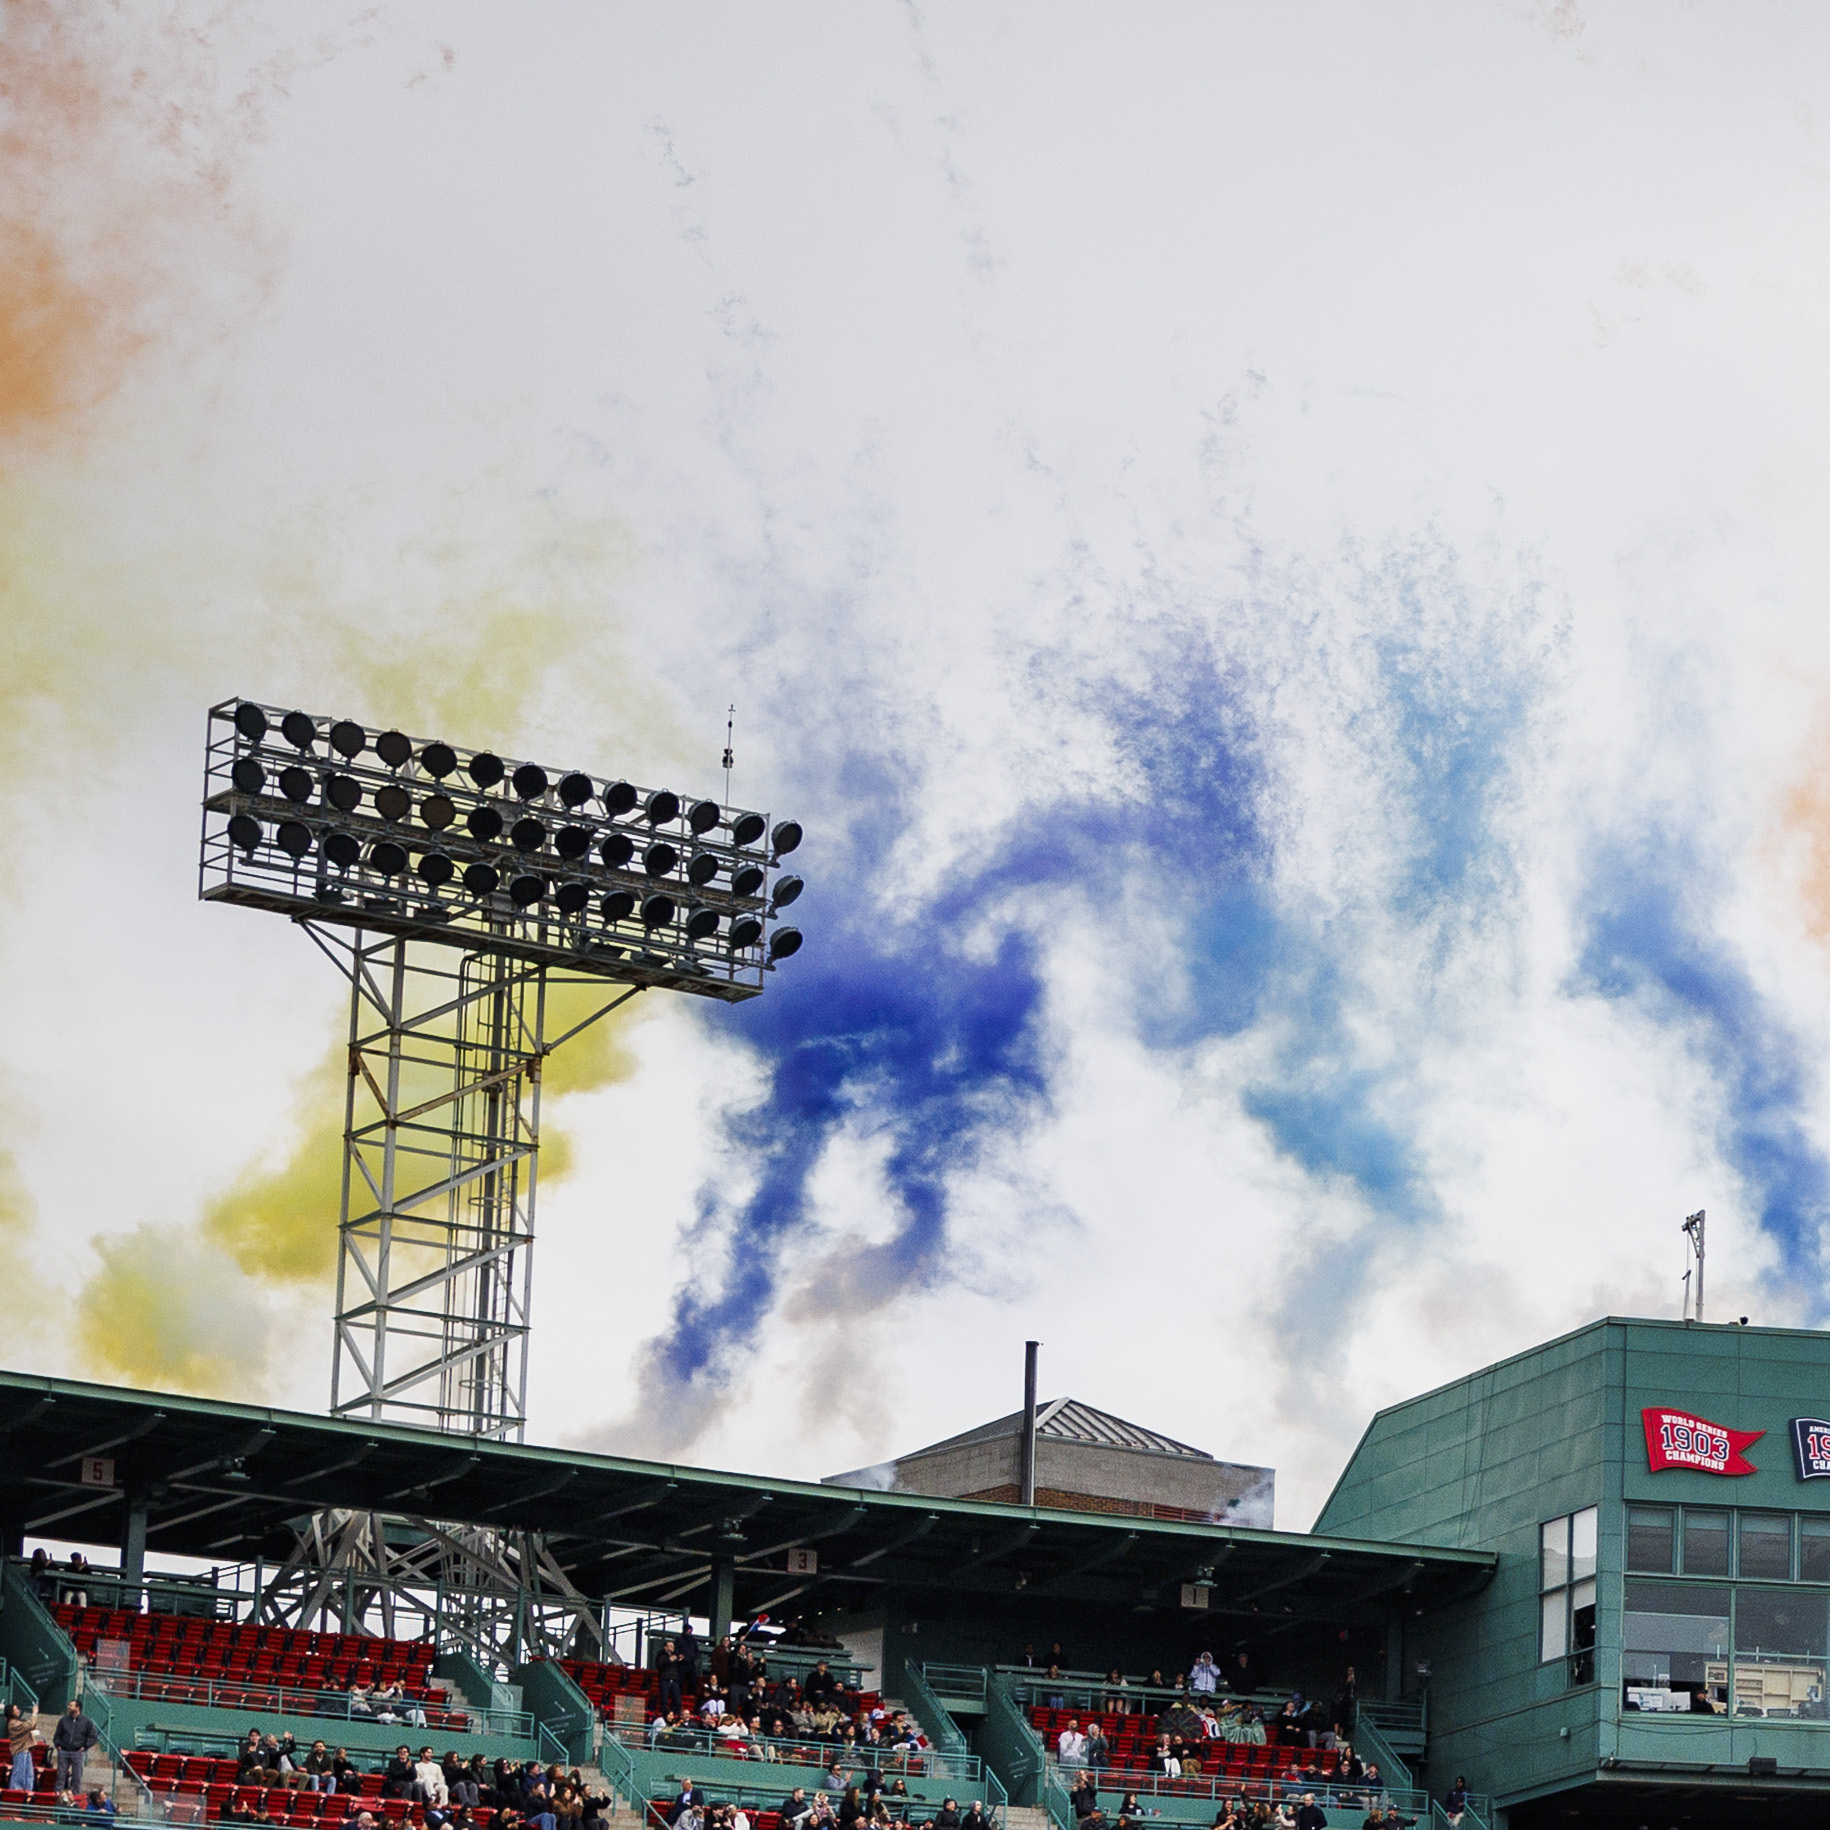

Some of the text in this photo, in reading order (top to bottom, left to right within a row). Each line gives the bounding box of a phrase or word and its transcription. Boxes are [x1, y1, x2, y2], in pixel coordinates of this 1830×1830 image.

[1661, 1415, 1728, 1439] WORLD SERIES
[1660, 1425, 1730, 1461] 1903
[1665, 1449, 1725, 1470] CHAMPIONS
[92, 1461, 103, 1481] 5
[798, 1552, 808, 1570] 3
[1192, 1588, 1199, 1604] 1
